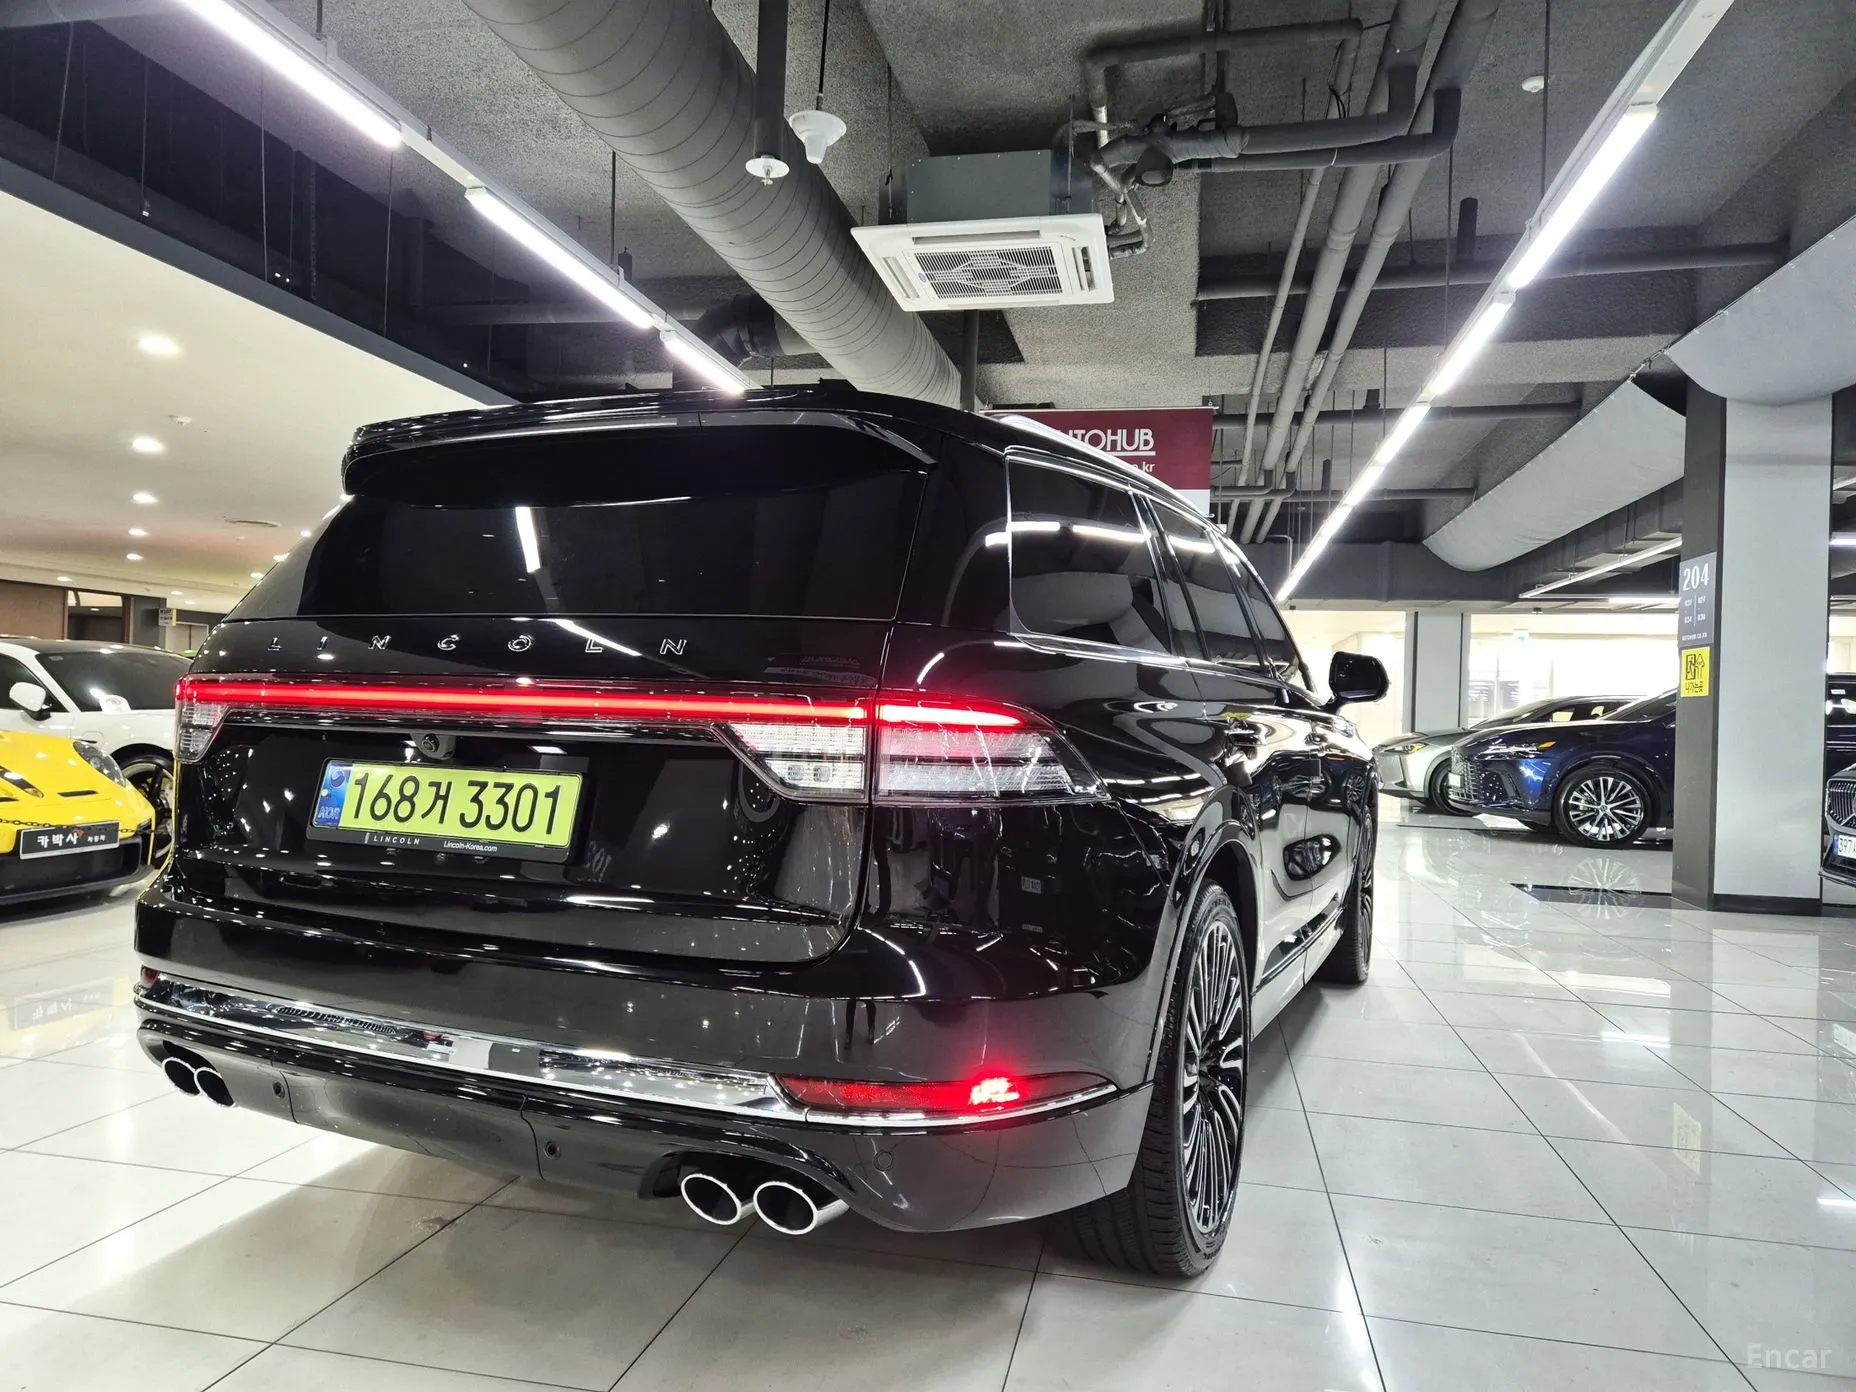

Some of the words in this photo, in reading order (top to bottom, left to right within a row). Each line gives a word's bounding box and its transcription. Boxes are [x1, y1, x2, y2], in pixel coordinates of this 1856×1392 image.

[1682, 563, 1709, 591] 204
[268, 634, 687, 655] LINCOLN
[354, 772, 453, 825] 168거
[459, 780, 561, 835] 3301
[317, 806, 340, 820] KOR
[37, 832, 79, 848] 카박사
[373, 835, 421, 846] LINCOLN
[443, 840, 498, 852] Lincoln-Korea.com
